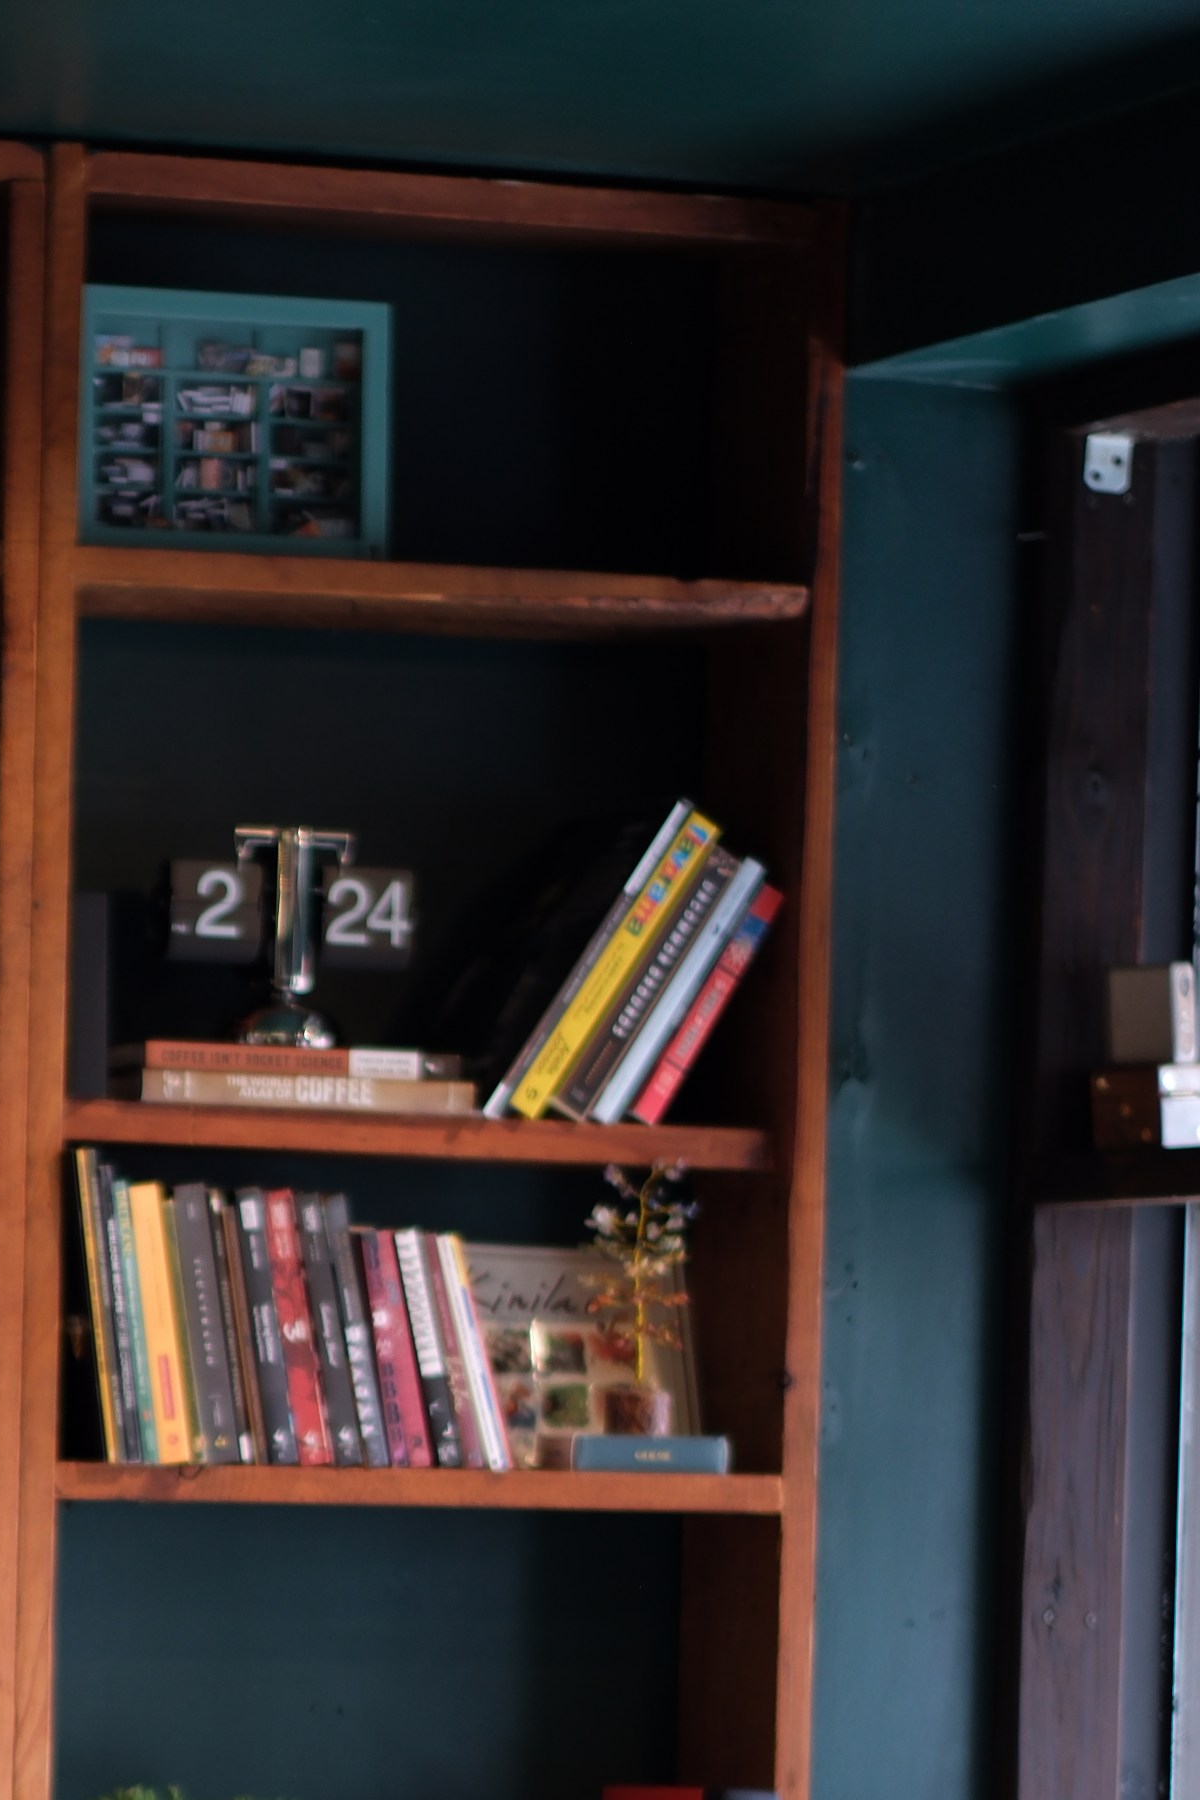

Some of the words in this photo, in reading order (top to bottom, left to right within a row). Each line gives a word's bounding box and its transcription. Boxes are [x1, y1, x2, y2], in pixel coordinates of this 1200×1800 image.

[195, 869, 241, 938] 2
[325, 878, 413, 948] 24
[621, 818, 712, 943] flavorama
[653, 876, 718, 969] UNCOMMON
[607, 961, 666, 1042] GROUNDS
[161, 1050, 205, 1065] COFFEE
[209, 1051, 240, 1066] ISN'T
[245, 1053, 291, 1068] ROCKET
[295, 1054, 344, 1070] SCIENCE
[295, 1076, 374, 1105] COFFEE
